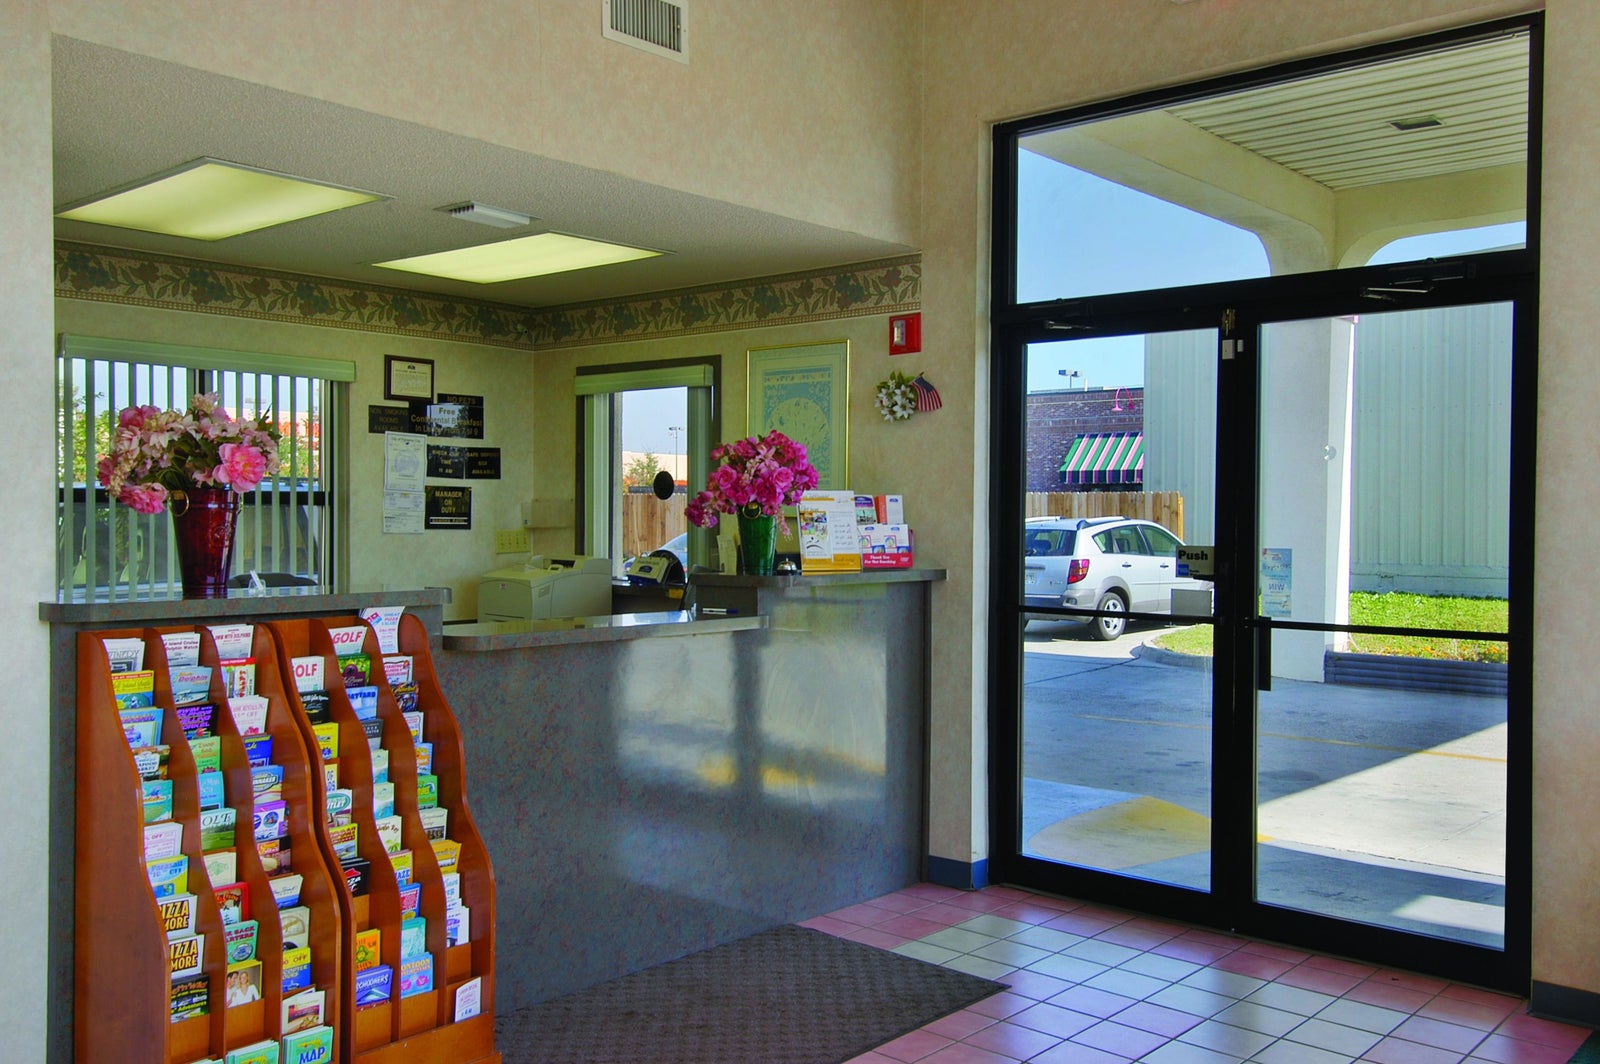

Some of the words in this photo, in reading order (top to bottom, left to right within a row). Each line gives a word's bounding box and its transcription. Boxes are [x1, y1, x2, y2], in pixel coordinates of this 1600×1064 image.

[439, 407, 456, 415] Free
[441, 506, 456, 514] DUTY
[1178, 550, 1208, 561] Push
[333, 631, 363, 644] GOLF
[292, 663, 318, 678] OLF
[171, 940, 198, 960] IZZA
[171, 955, 198, 971] MORE
[300, 1046, 326, 1064] MAP
